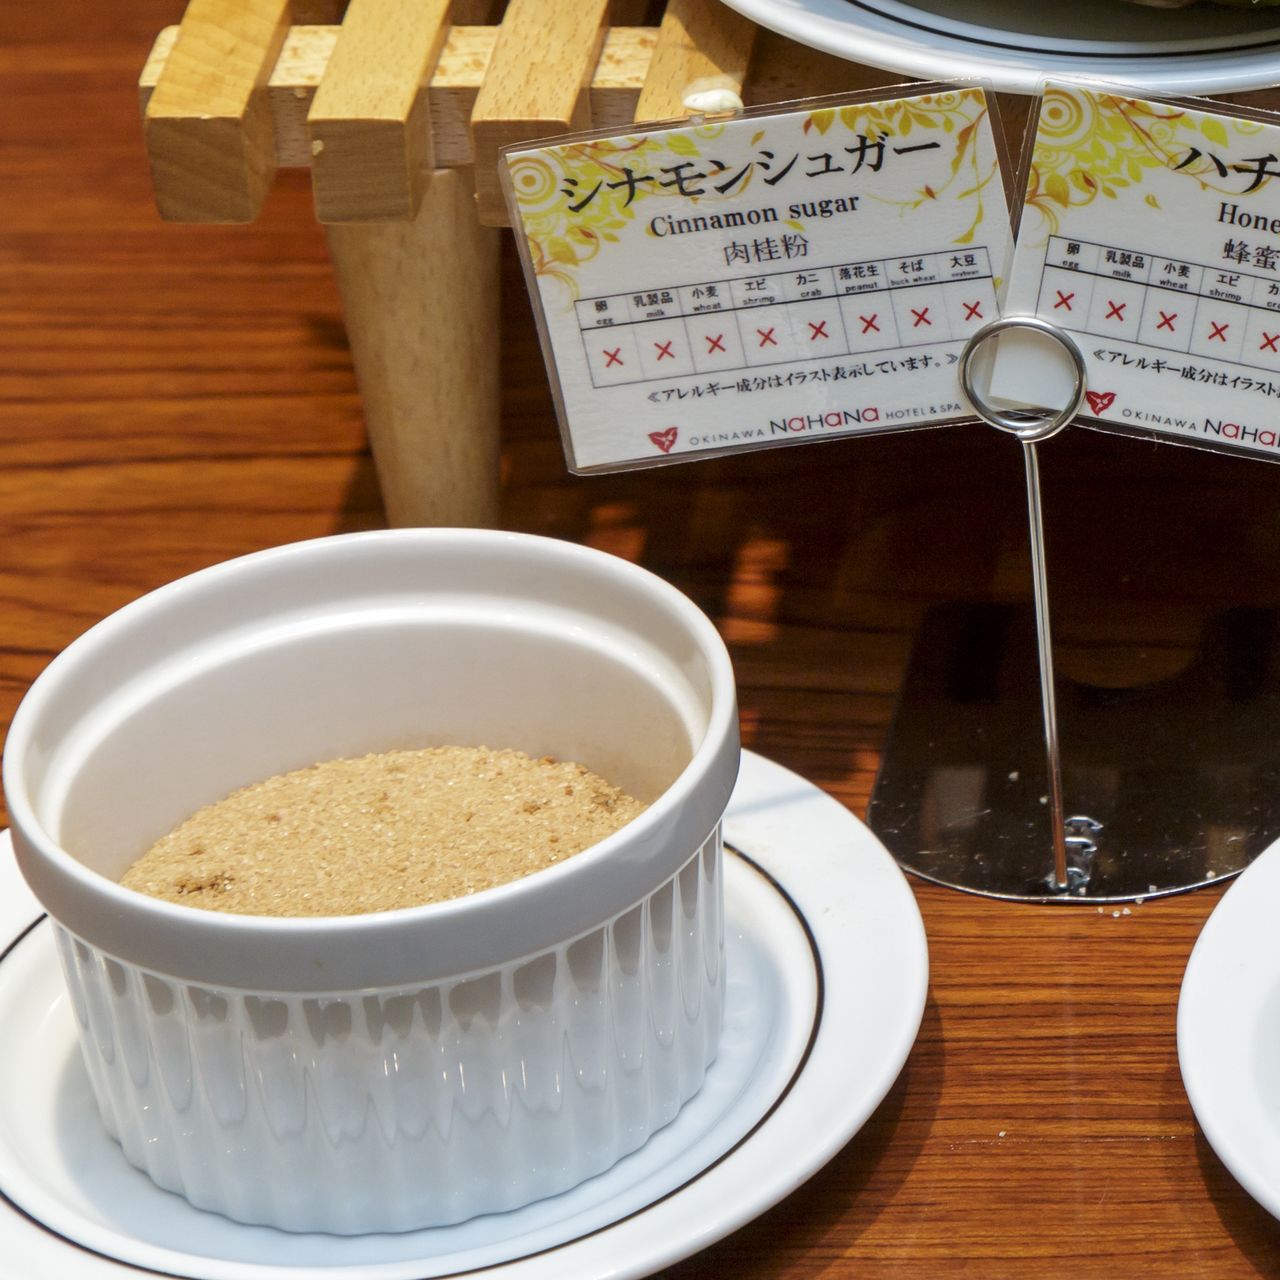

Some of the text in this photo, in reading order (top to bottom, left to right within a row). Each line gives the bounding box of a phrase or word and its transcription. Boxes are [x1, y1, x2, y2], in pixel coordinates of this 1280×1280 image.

[561, 130, 942, 214] シナモンシュガー
[650, 193, 860, 239] Cinnamon sugar
[723, 234, 809, 266] 肉桂粉
[1066, 242, 1080, 255] 卵
[1105, 249, 1145, 269] 乳製品
[1164, 262, 1191, 278] 小麦
[1216, 274, 1241, 287] エビ
[633, 291, 673, 308] 乳製品
[692, 285, 719, 300] 小麦
[744, 278, 767, 292] エビ
[796, 273, 819, 286] カニ
[839, 264, 880, 280] 落花生
[899, 259, 925, 274] そば
[951, 254, 977, 268] 大豆
[646, 309, 665, 318] milk
[693, 302, 722, 312] wheat
[743, 295, 776, 306] shrimp
[800, 288, 822, 299] crab
[845, 282, 880, 293] peanut
[1112, 269, 1132, 279] milk
[1159, 278, 1188, 290] wheat
[1209, 288, 1242, 302] shrimp
[689, 428, 765, 447] OKINAWA
[885, 407, 926, 421] HOTEL
[939, 402, 963, 414] SPA
[1122, 407, 1197, 432] OKINAWA
